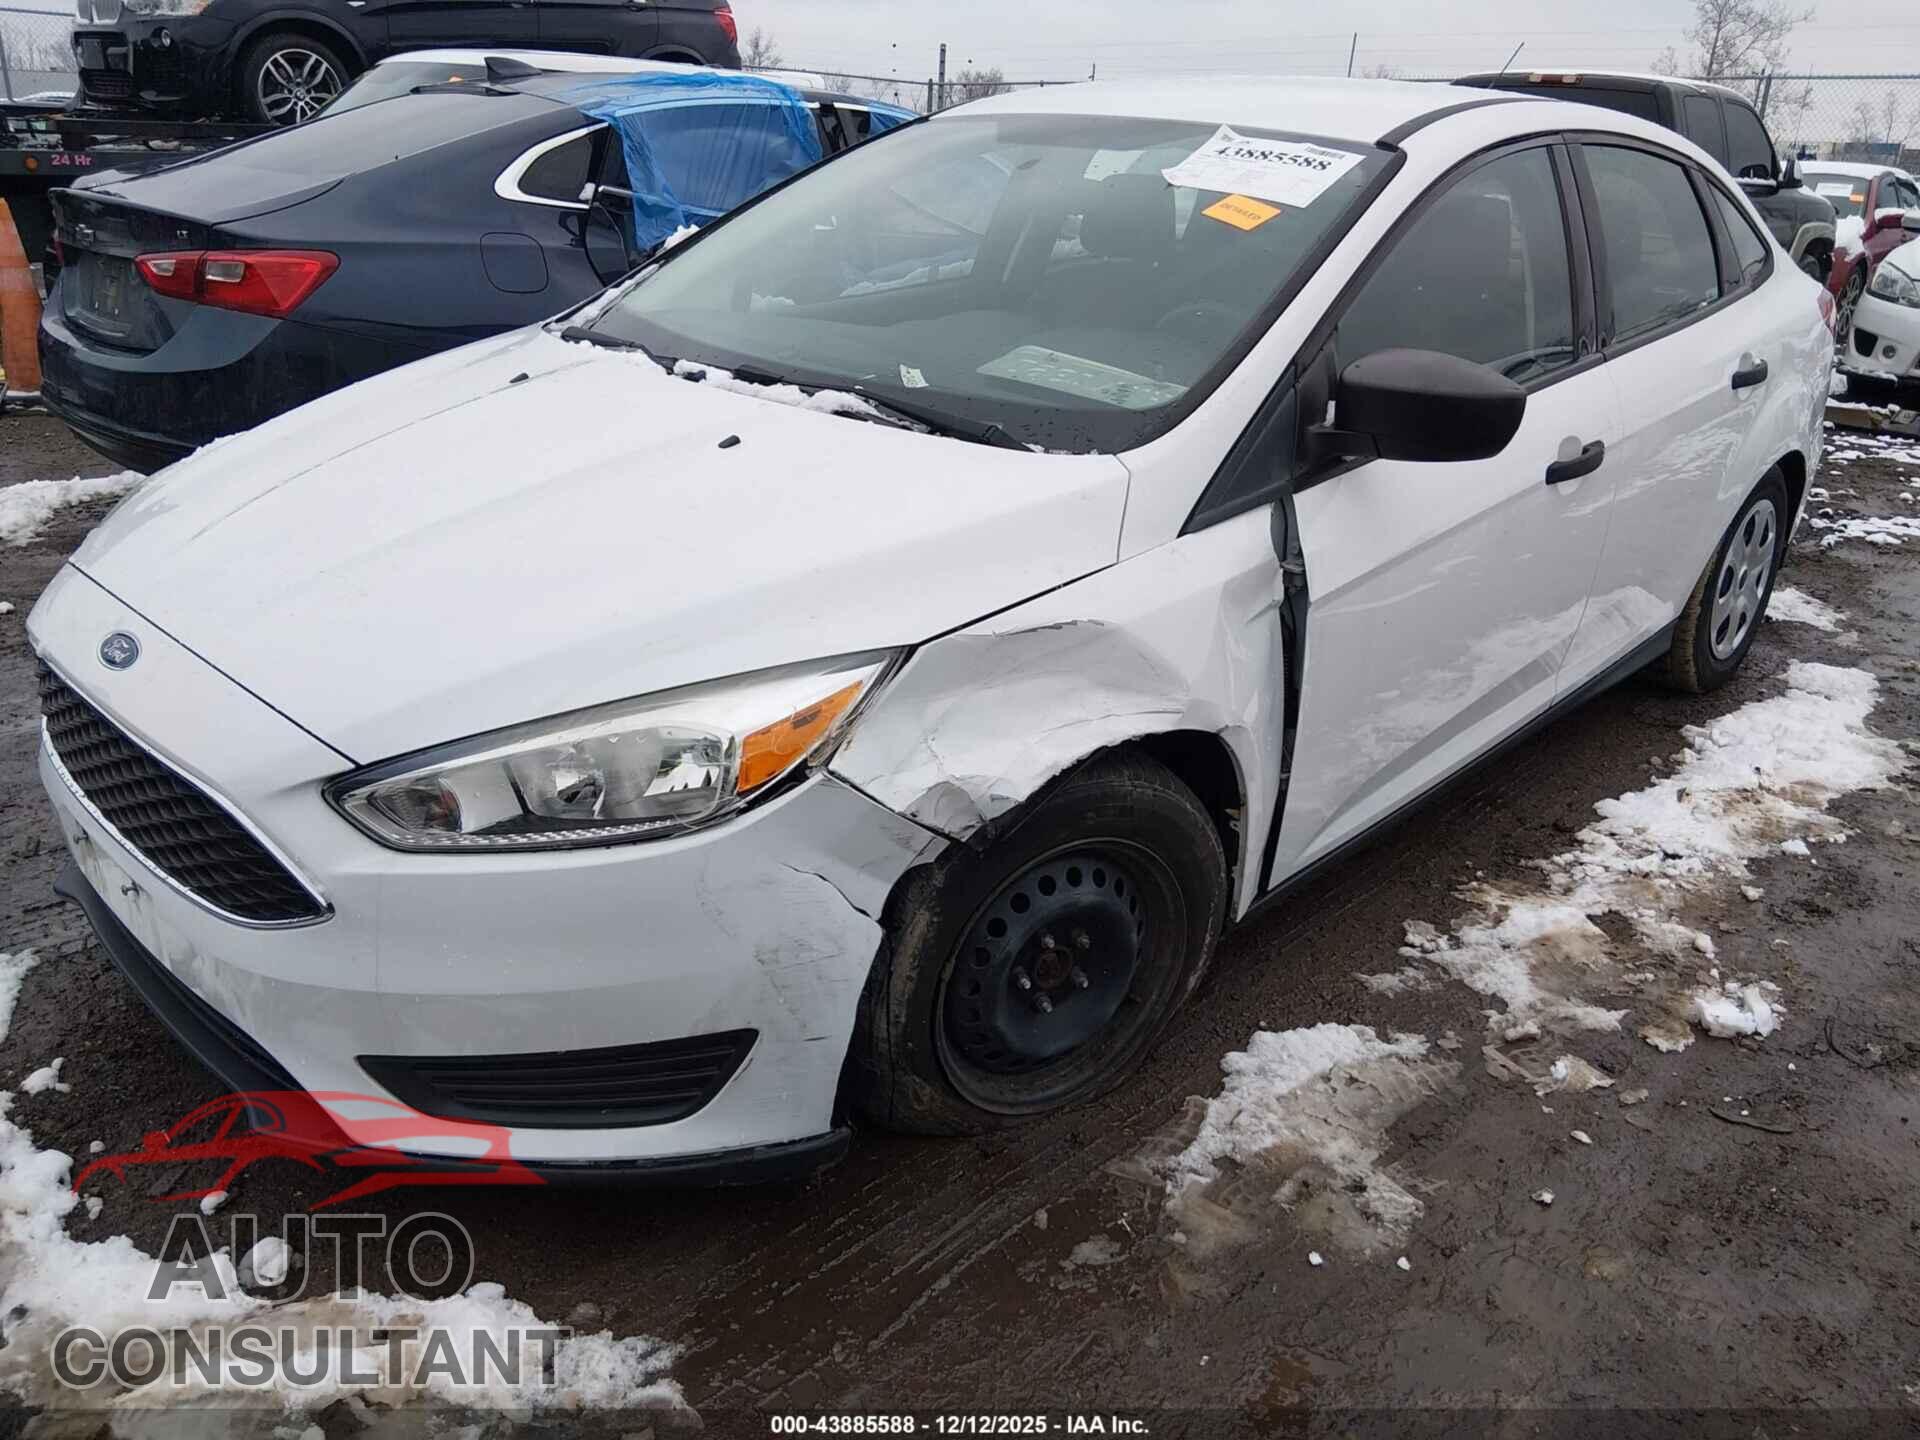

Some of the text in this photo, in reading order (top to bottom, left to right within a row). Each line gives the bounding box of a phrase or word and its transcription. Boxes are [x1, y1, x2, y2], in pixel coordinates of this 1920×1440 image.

[51, 154, 93, 166] 24 Hr
[1214, 146, 1332, 171] 43885588
